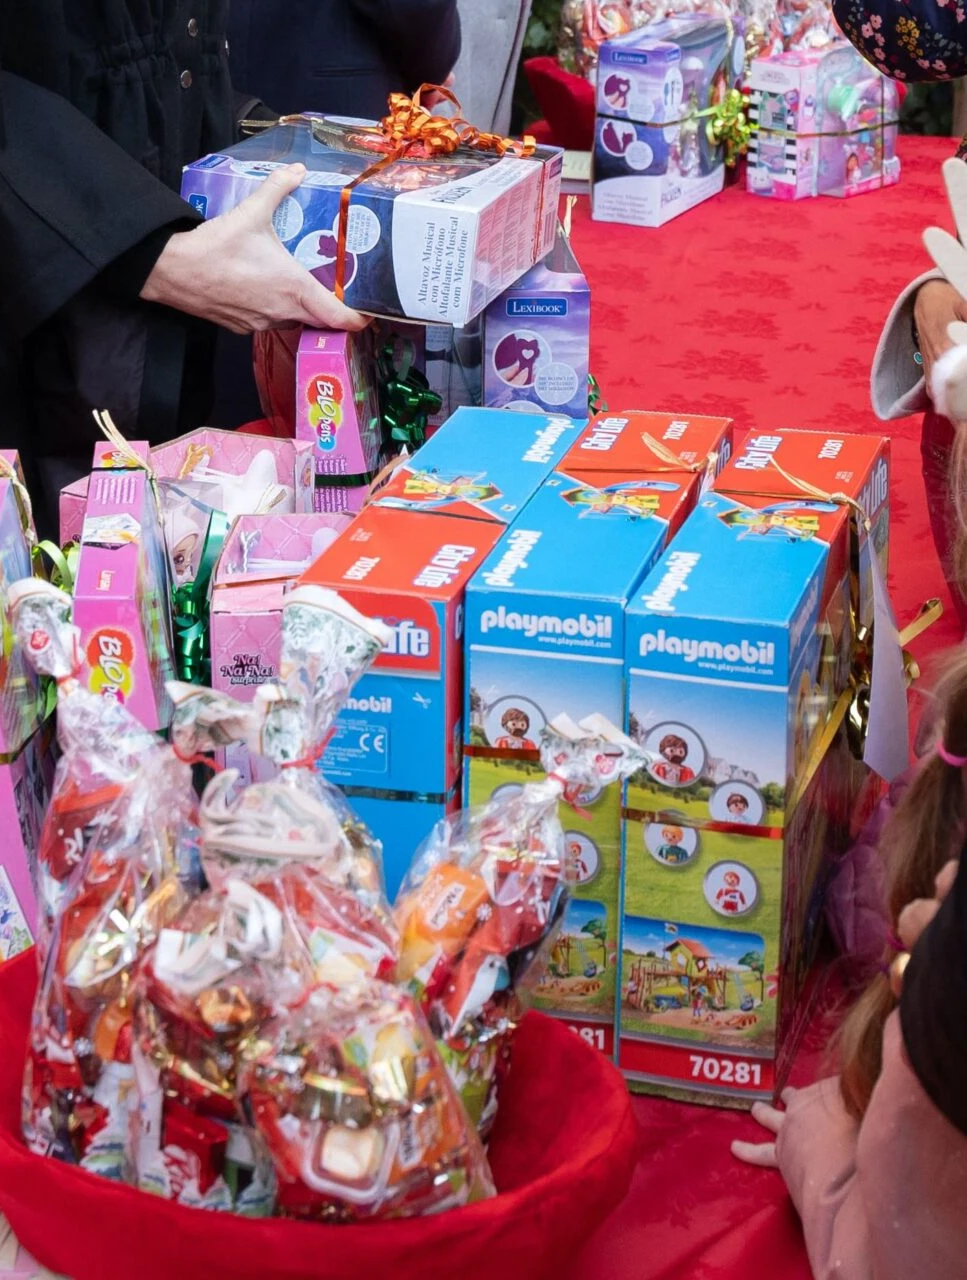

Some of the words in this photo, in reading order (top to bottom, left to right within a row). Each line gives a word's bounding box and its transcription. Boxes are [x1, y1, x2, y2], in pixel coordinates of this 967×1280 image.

[422, 222, 435, 261] Musical
[454, 230, 468, 282] Microfone
[439, 262, 453, 317] Altofalante
[446, 216, 459, 257] Musical
[418, 265, 431, 305] Altavoz
[431, 285, 439, 303] con
[453, 287, 462, 308] com
[318, 416, 332, 443] pens
[480, 605, 613, 639] playmobil
[379, 620, 430, 657] ife
[538, 634, 612, 649] www.playmobil.com
[639, 629, 775, 665] playmobil
[698, 661, 774, 676] www.playmobil.com
[343, 695, 392, 713] mobil
[690, 1055, 761, 1085] 70281
